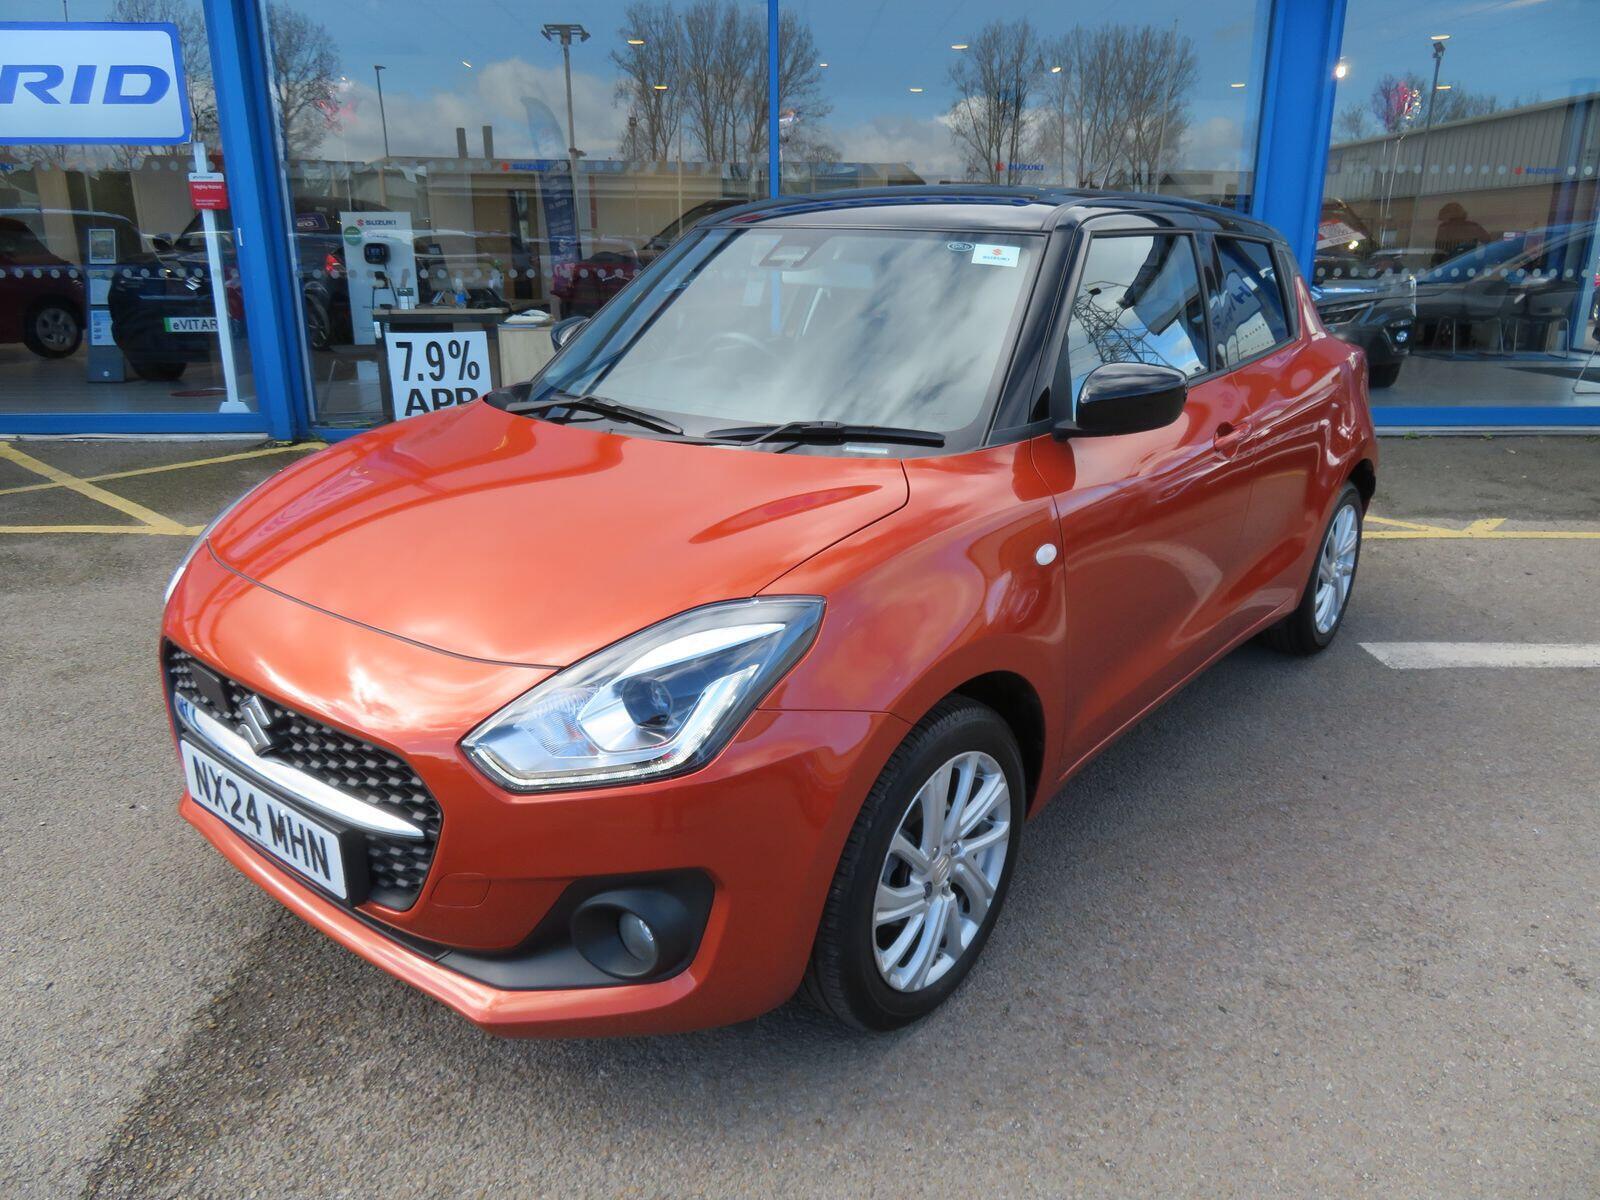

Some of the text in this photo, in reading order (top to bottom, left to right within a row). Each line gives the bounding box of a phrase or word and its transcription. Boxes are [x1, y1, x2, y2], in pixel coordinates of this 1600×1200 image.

[0, 65, 170, 104] RID
[173, 319, 219, 330] eVITAR
[395, 340, 480, 382] 7.9%
[192, 754, 332, 882] NX24 MHN
